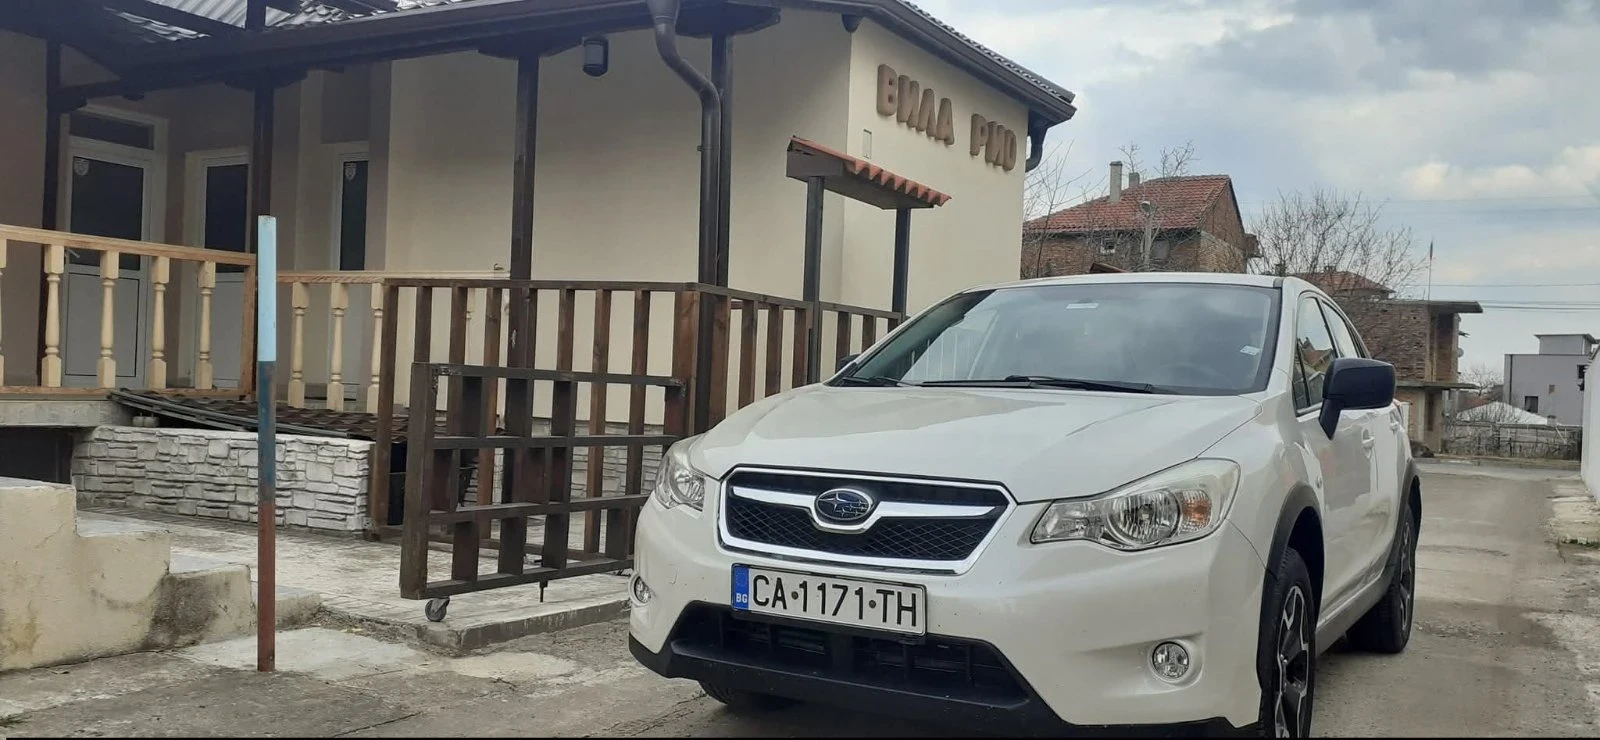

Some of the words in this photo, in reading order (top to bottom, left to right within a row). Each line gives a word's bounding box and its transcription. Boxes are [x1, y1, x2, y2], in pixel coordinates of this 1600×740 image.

[876, 64, 955, 145] ВИЛА
[969, 113, 1018, 171] РИО
[735, 592, 748, 604] BG
